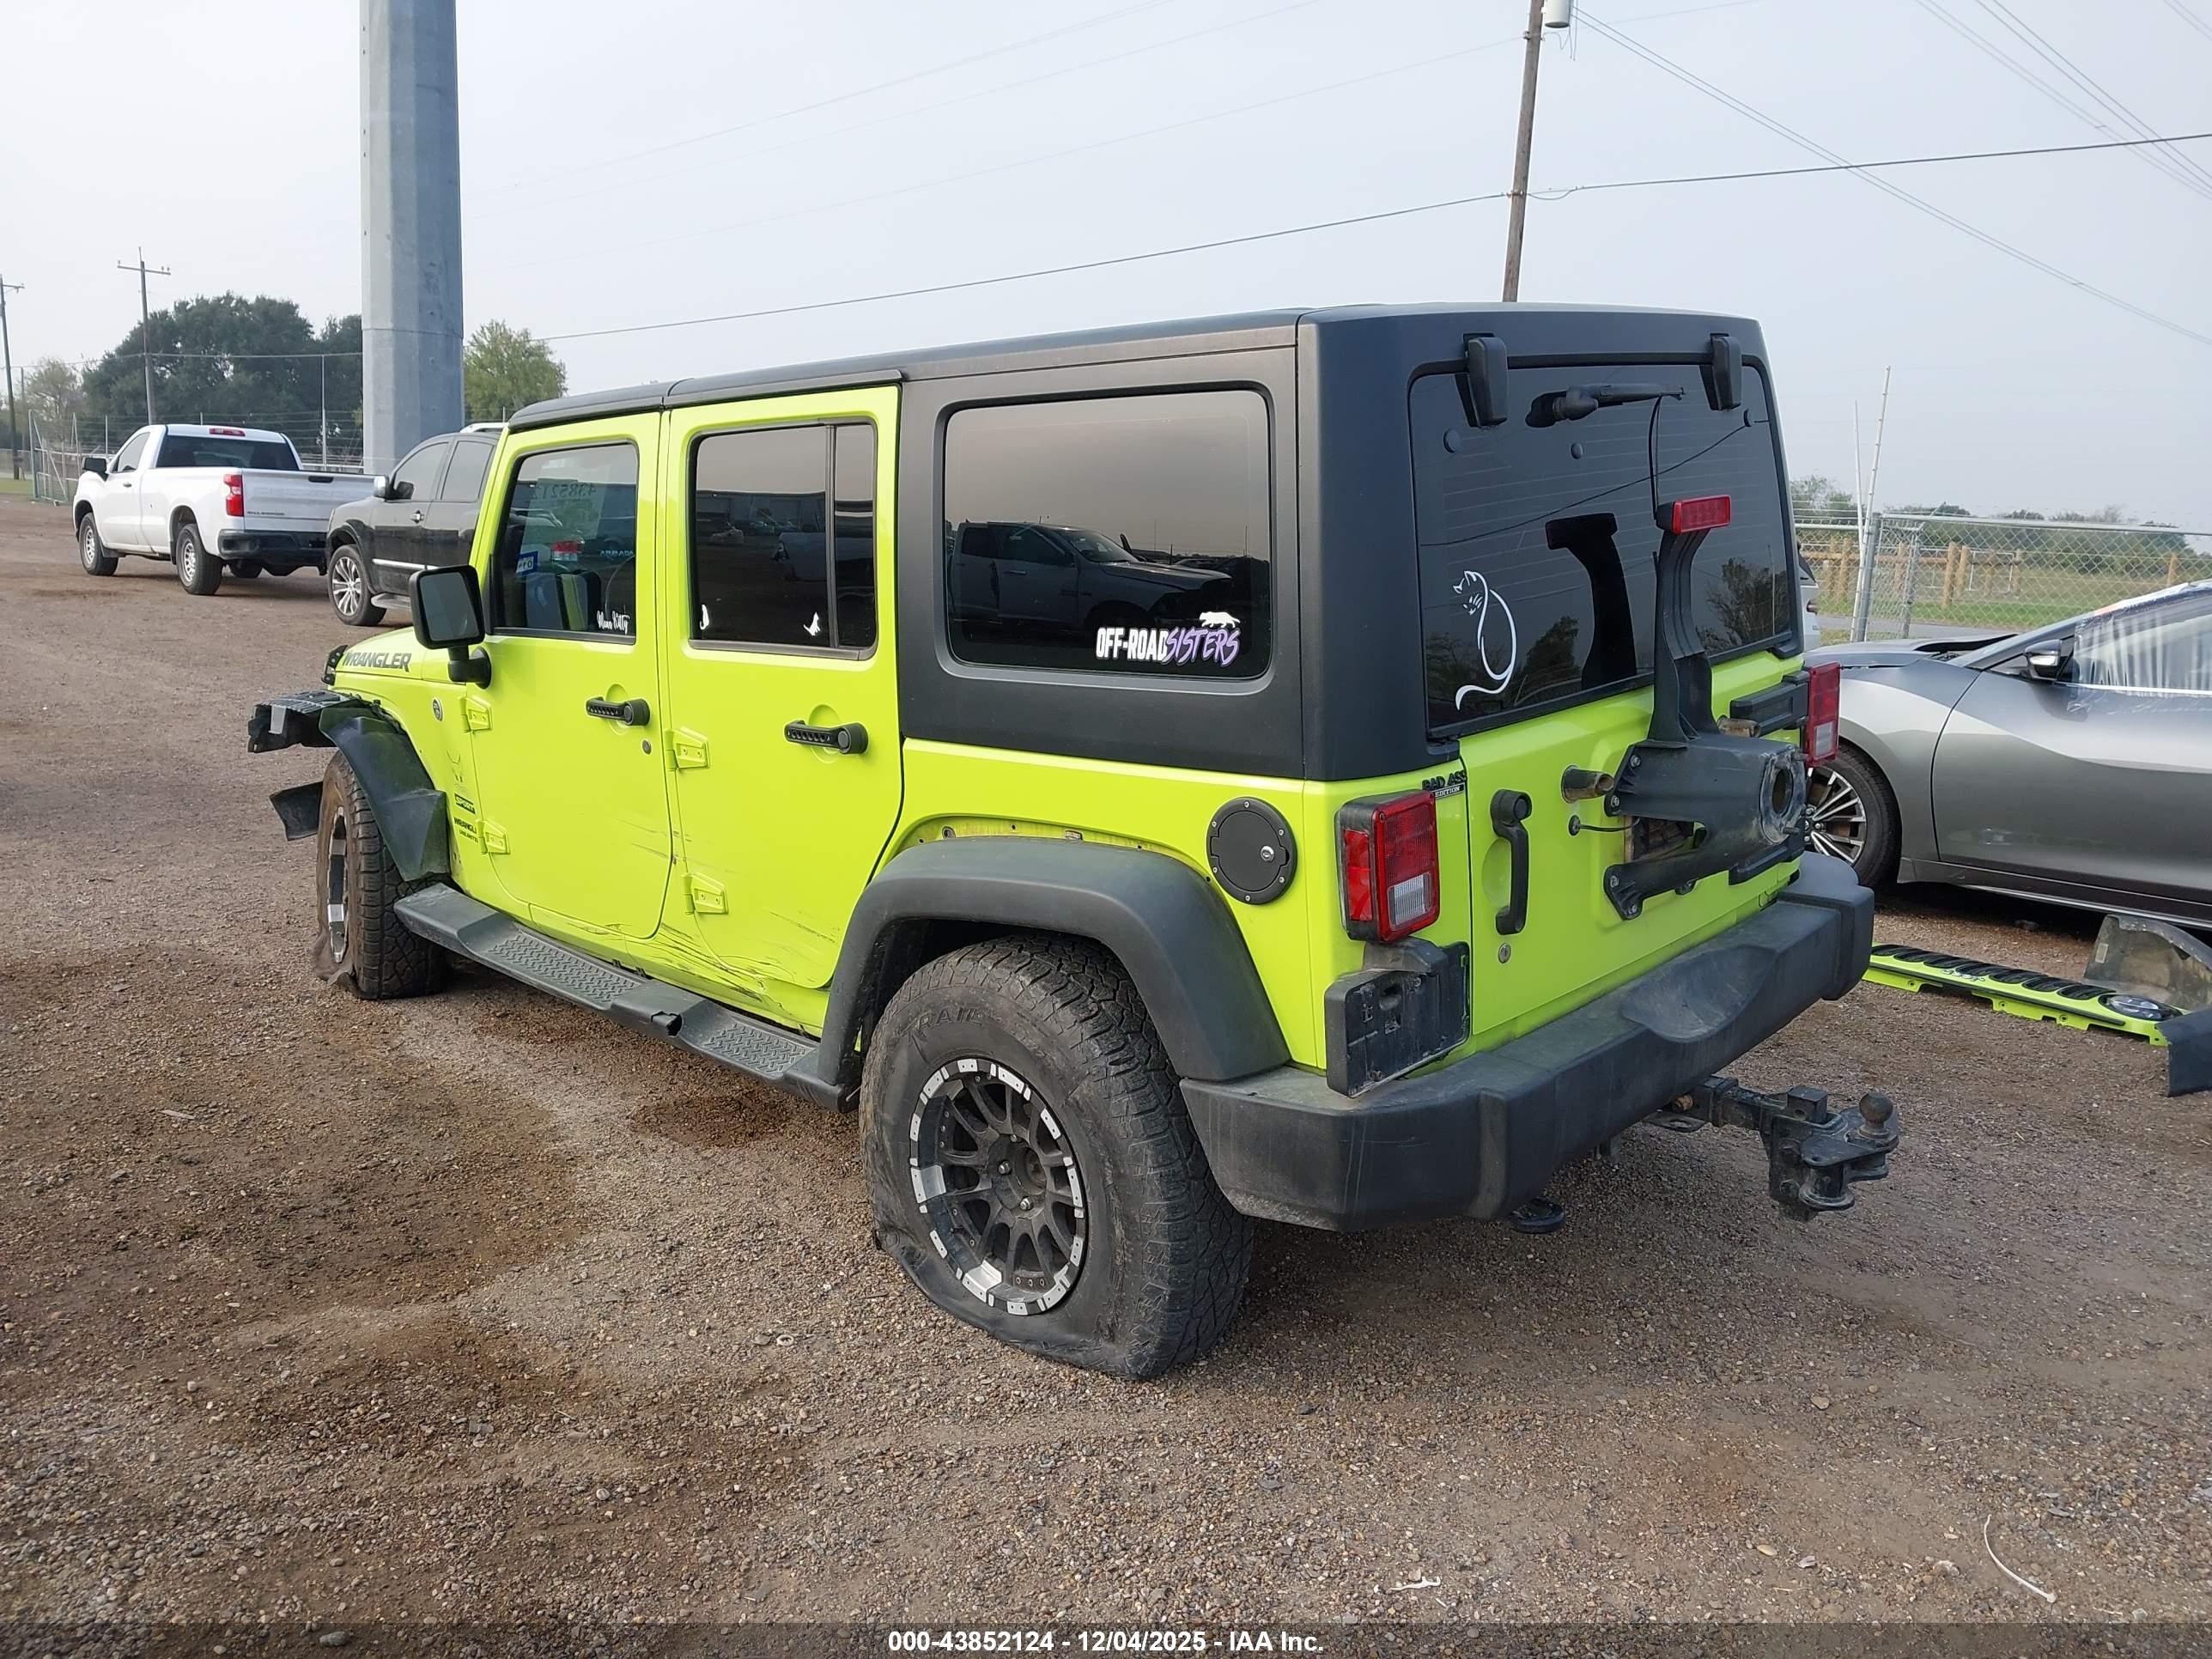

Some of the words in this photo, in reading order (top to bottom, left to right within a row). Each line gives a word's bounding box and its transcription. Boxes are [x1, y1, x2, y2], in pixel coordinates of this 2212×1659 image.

[342, 652, 412, 673] WRANGLER
[1435, 785, 1461, 798] EDITION
[453, 817, 477, 834] WRANGL
